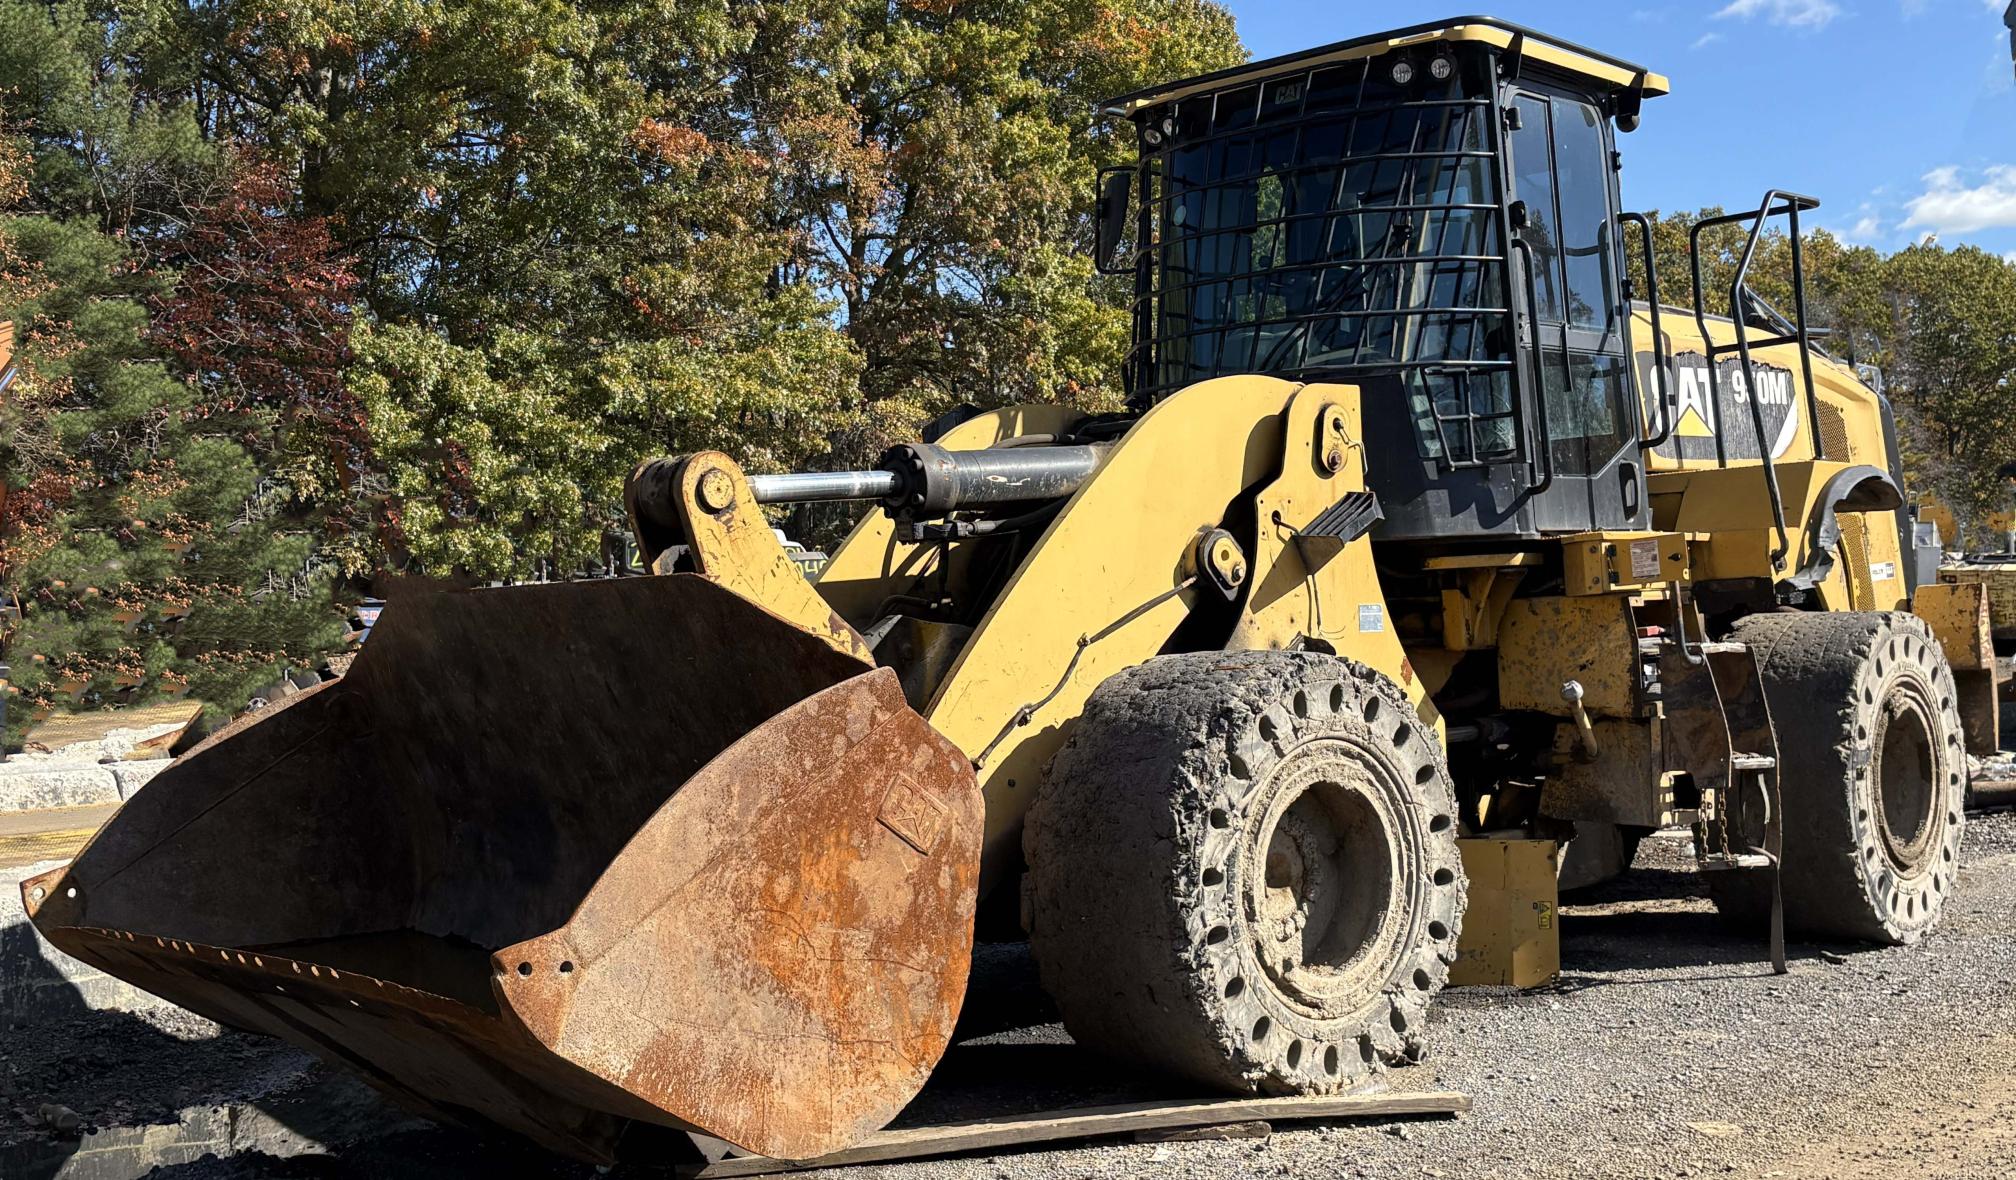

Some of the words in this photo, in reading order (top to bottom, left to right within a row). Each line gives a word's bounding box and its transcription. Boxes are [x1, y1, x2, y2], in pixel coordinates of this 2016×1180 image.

[1274, 82, 1305, 105] CAT
[1650, 365, 1721, 437] CAT
[1731, 369, 1788, 405] 90M
[889, 782, 943, 845] CAT
